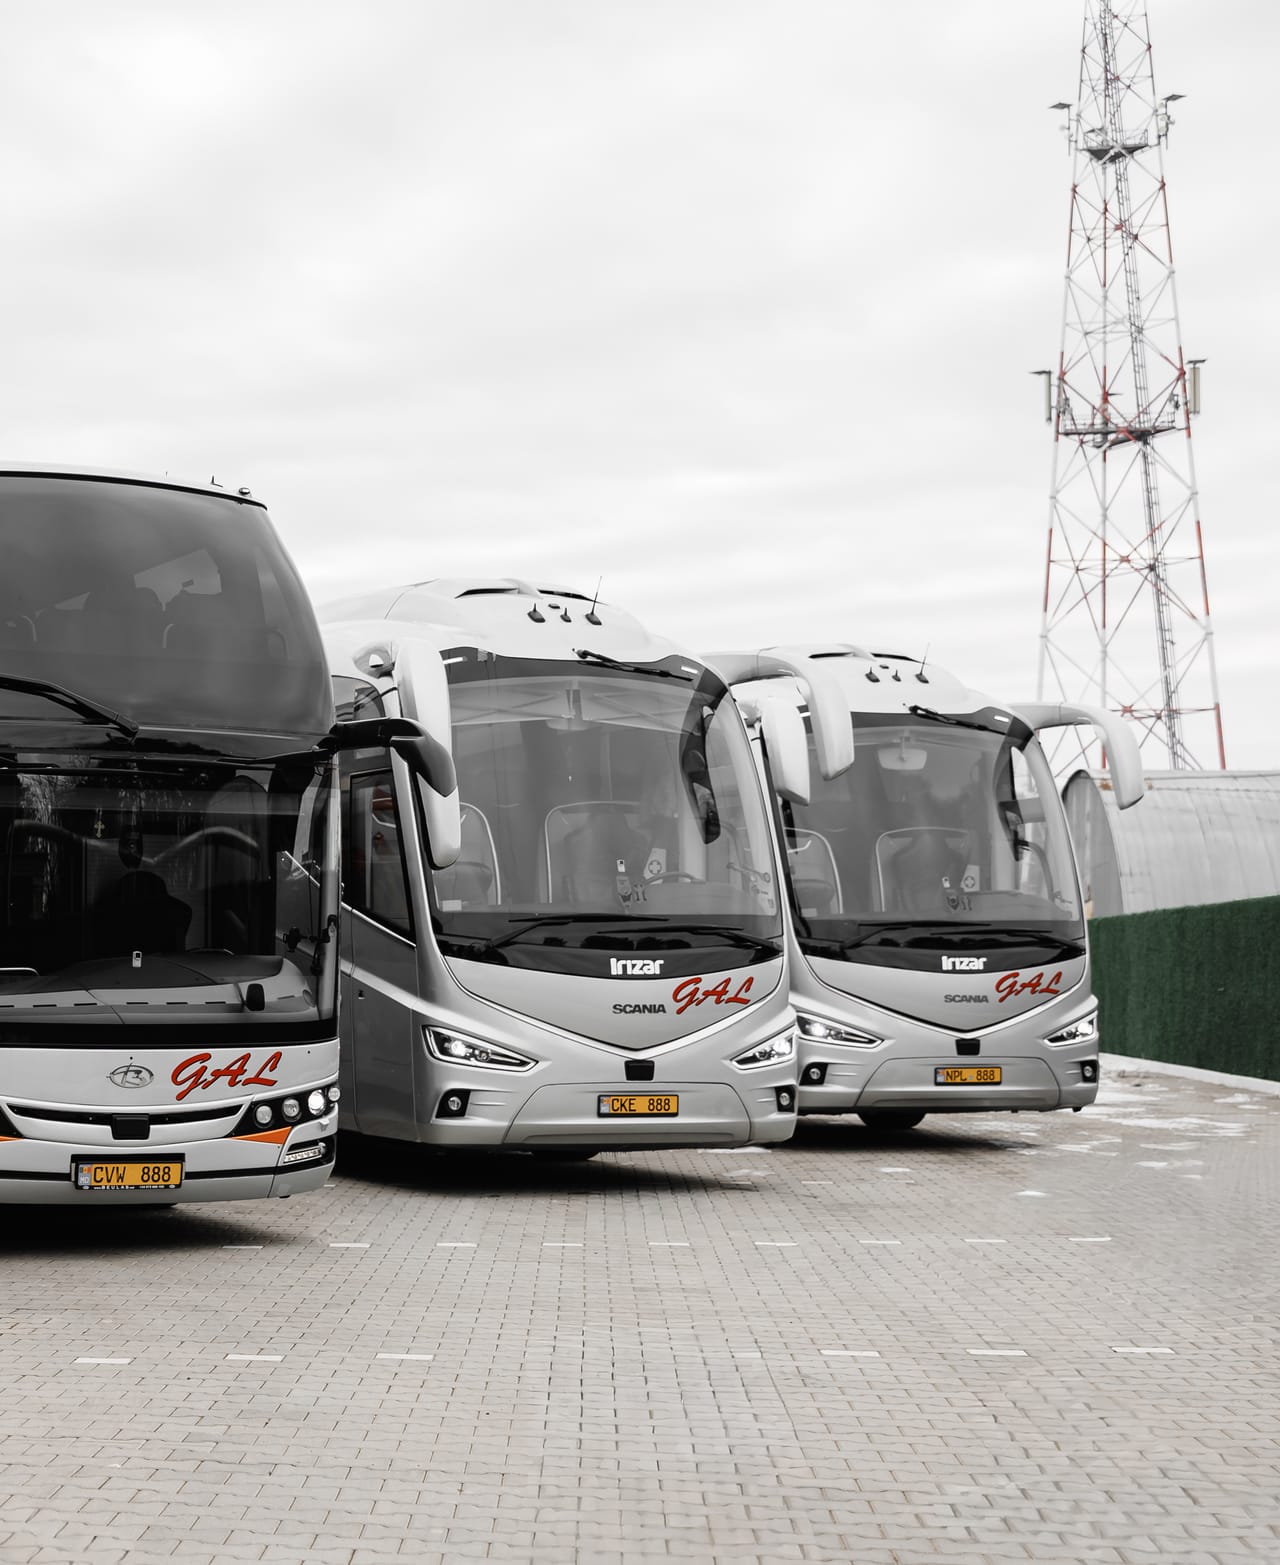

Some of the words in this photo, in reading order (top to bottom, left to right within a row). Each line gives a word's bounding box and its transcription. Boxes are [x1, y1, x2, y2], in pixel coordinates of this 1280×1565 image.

[610, 957, 665, 976] Irizar
[941, 955, 987, 971] Irizar
[995, 970, 1063, 1003] GAL
[672, 976, 754, 1015] GAL
[943, 994, 989, 1004] SCANIA
[612, 1003, 667, 1014] SCANIA
[171, 1051, 283, 1101] GAL
[945, 1070, 967, 1081] NPL
[976, 1069, 995, 1081] 888
[611, 1098, 637, 1112] CKE
[647, 1097, 671, 1112] 888
[93, 1166, 127, 1184] CVW
[140, 1166, 171, 1183] 888
